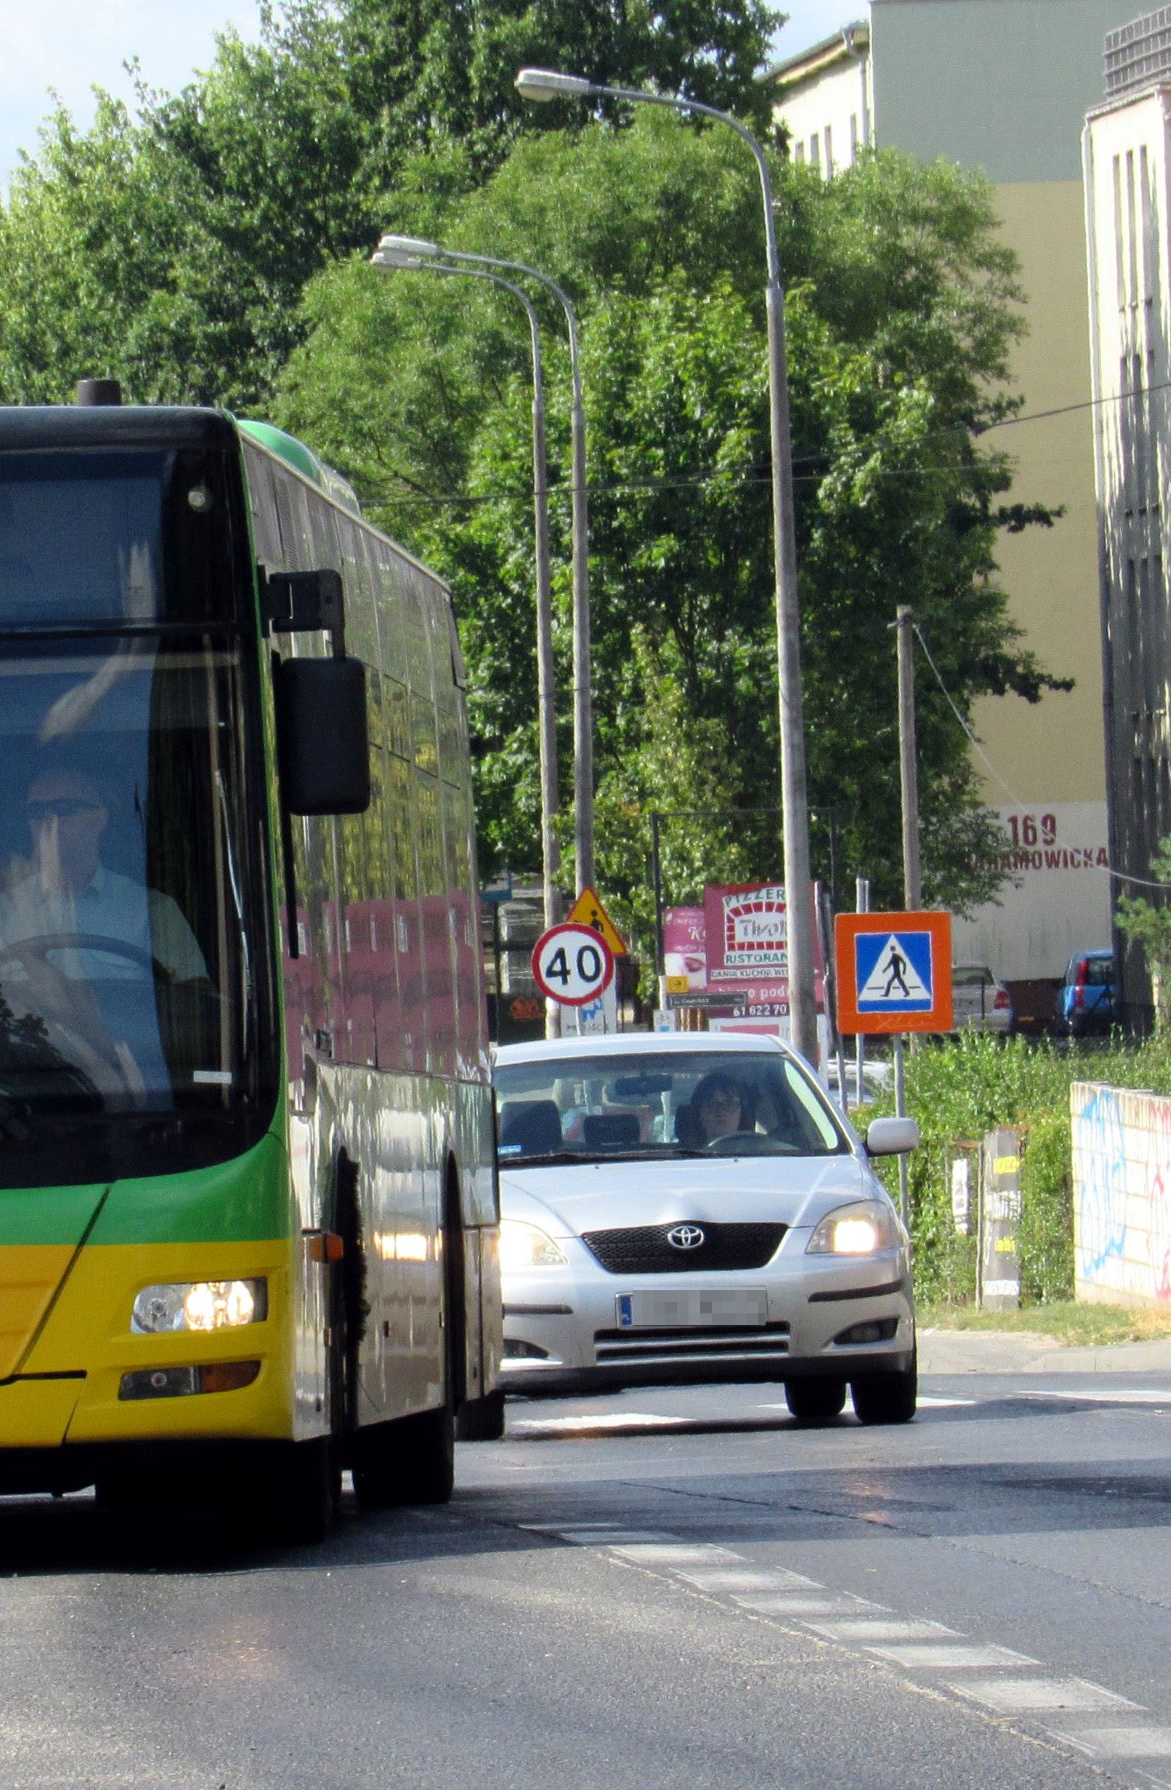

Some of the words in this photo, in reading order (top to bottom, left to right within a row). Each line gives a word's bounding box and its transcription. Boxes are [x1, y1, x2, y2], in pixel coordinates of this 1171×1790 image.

[1007, 813, 1057, 846] 169
[725, 888, 785, 907] PIZZER
[545, 945, 601, 986] 40
[733, 1006, 747, 1017] 61
[749, 1005, 771, 1015] 822
